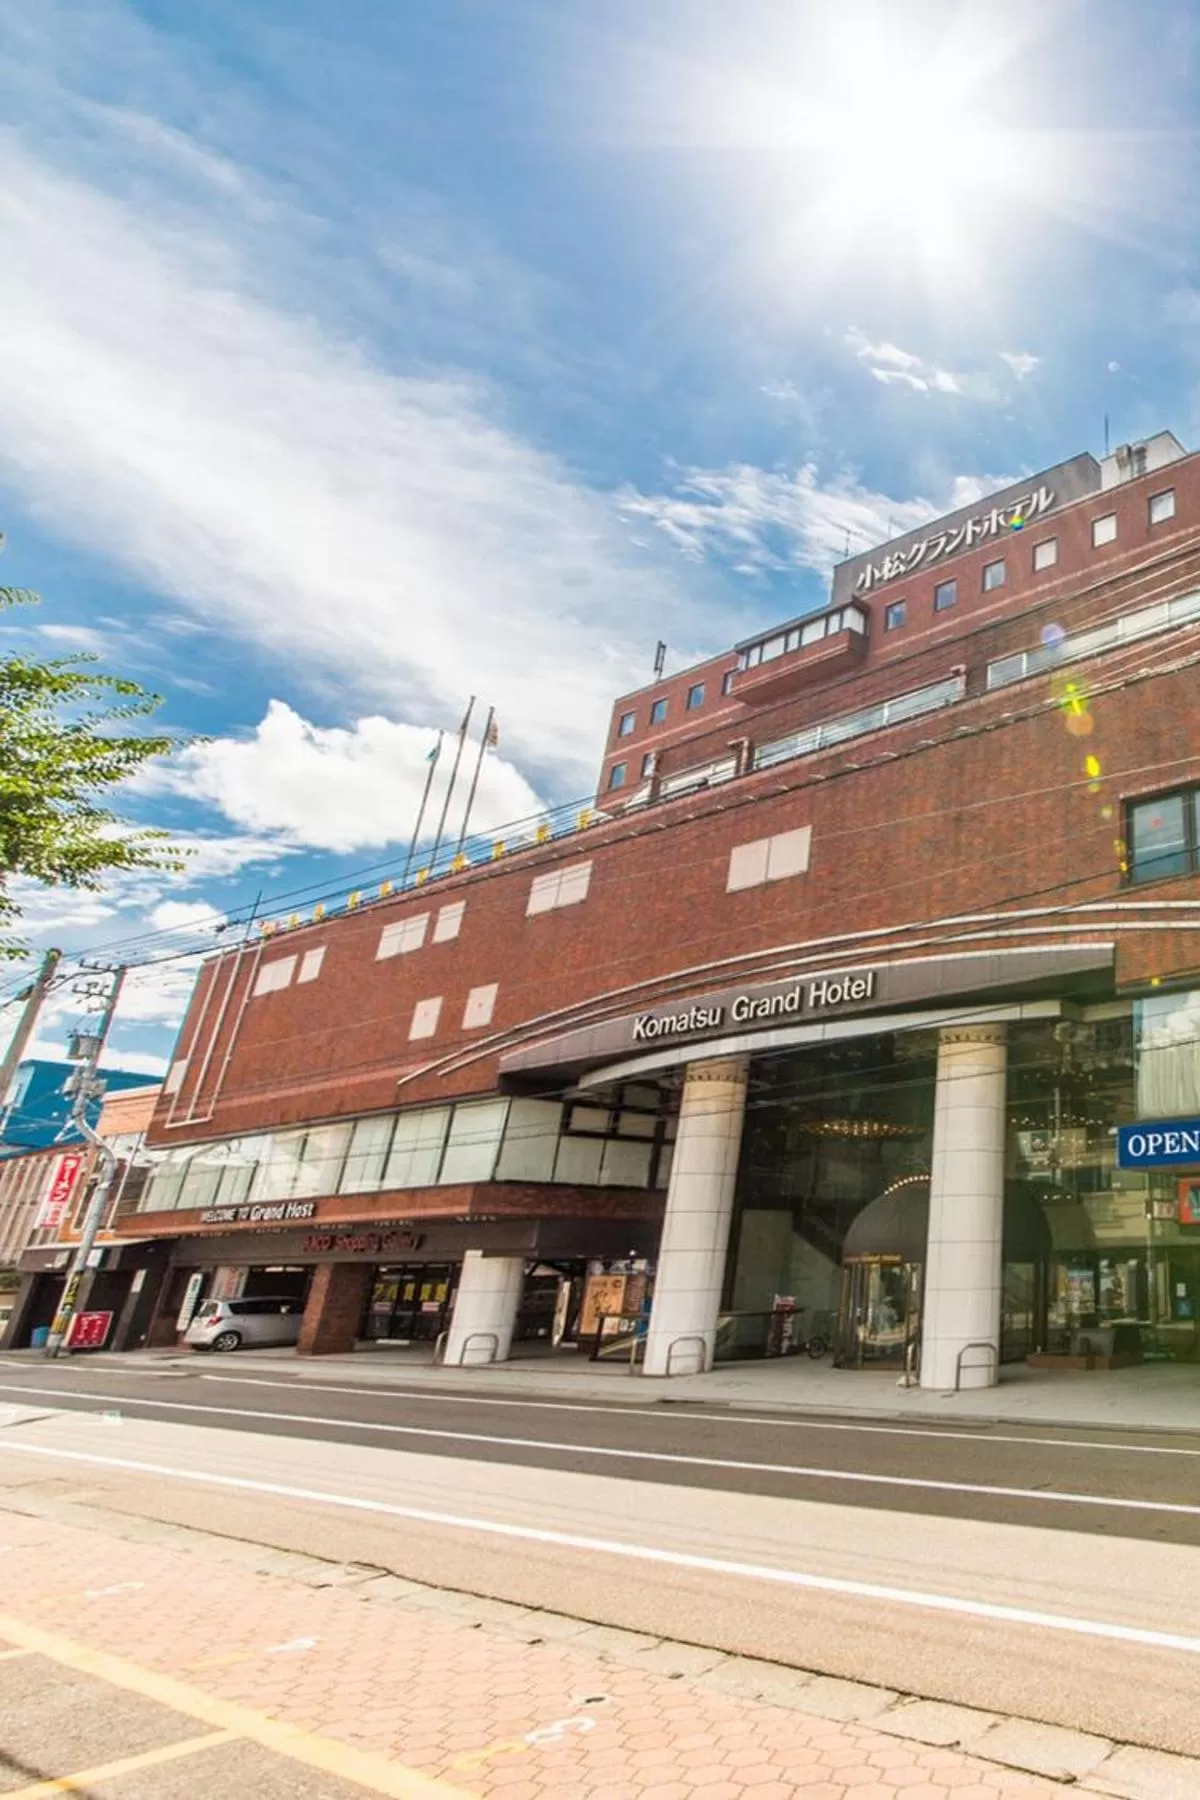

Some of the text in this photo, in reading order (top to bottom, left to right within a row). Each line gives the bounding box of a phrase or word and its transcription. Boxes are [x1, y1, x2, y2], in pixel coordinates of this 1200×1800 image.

[856, 486, 1054, 589] 小松グランドホテル
[632, 971, 875, 1040] Komatsu Grand Hotel
[1127, 1131, 1200, 1157] OPEN
[250, 1203, 287, 1221] Grand
[287, 1202, 315, 1218] Host
